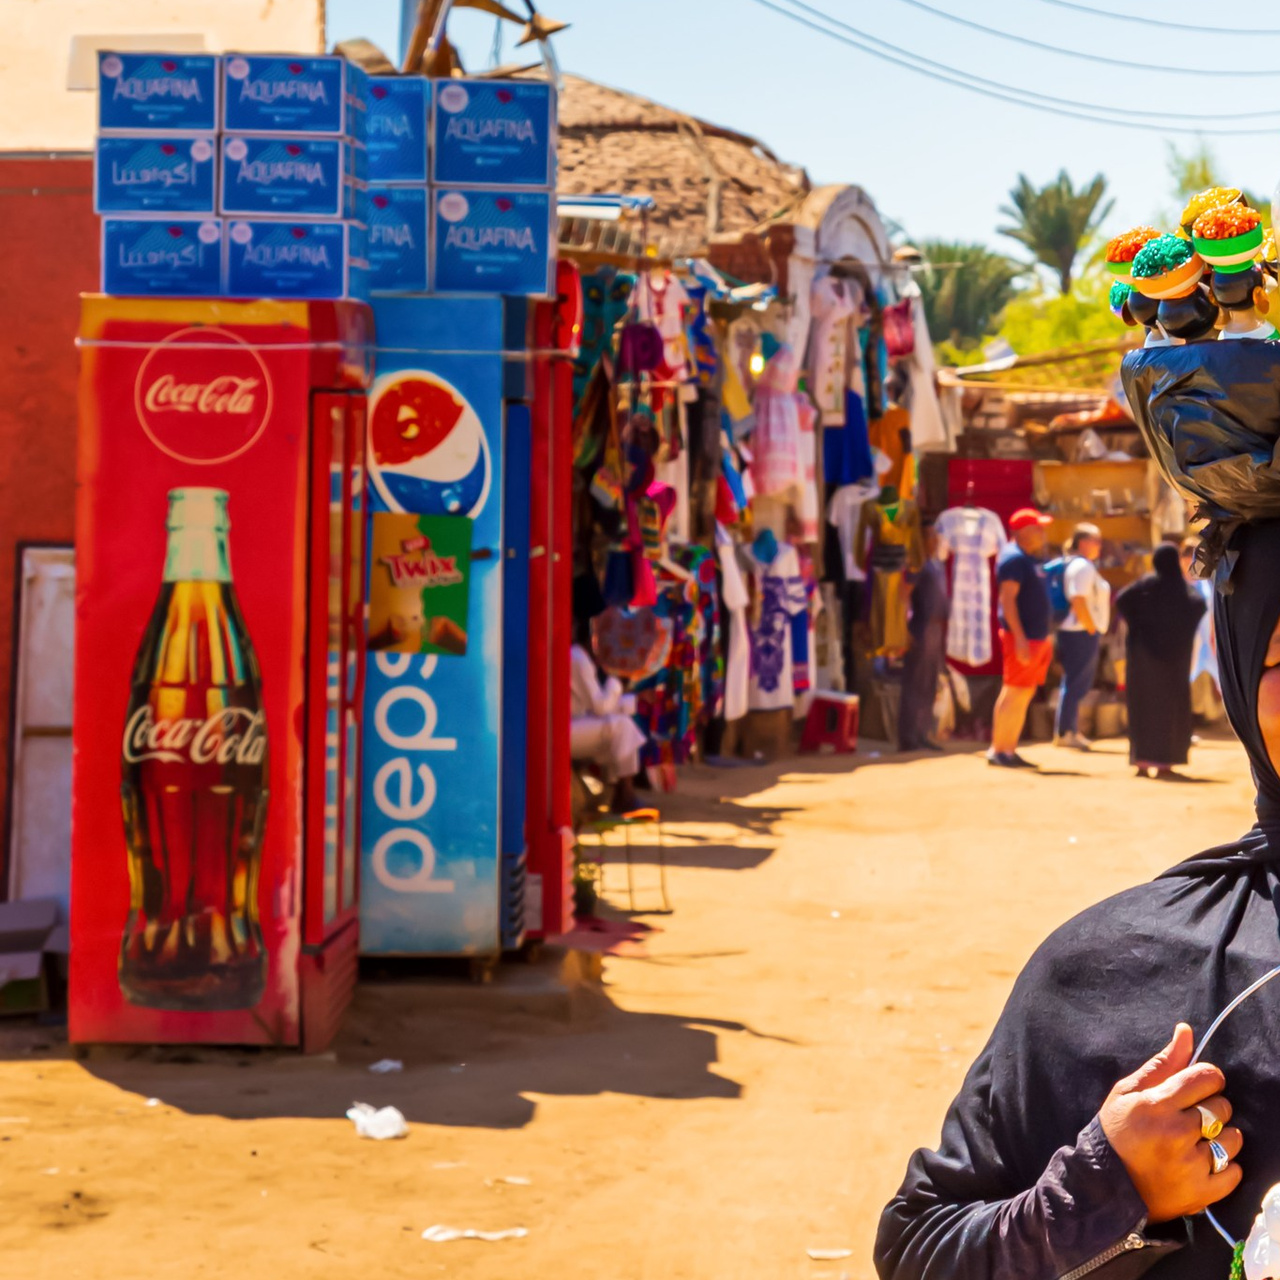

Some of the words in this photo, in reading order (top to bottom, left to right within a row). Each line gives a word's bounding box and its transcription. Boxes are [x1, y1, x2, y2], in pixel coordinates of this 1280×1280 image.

[112, 75, 203, 102] AQUAFINA
[238, 77, 329, 105] AQUAFINA
[444, 116, 538, 145] AQUAFINA
[236, 160, 327, 187] AQUAFINA
[368, 223, 416, 249] FINA
[444, 224, 538, 253] AQUAFINA
[241, 242, 332, 270] AQUAFINA
[145, 374, 260, 414] Coca-Cola
[122, 704, 267, 765] Coca-Cola
